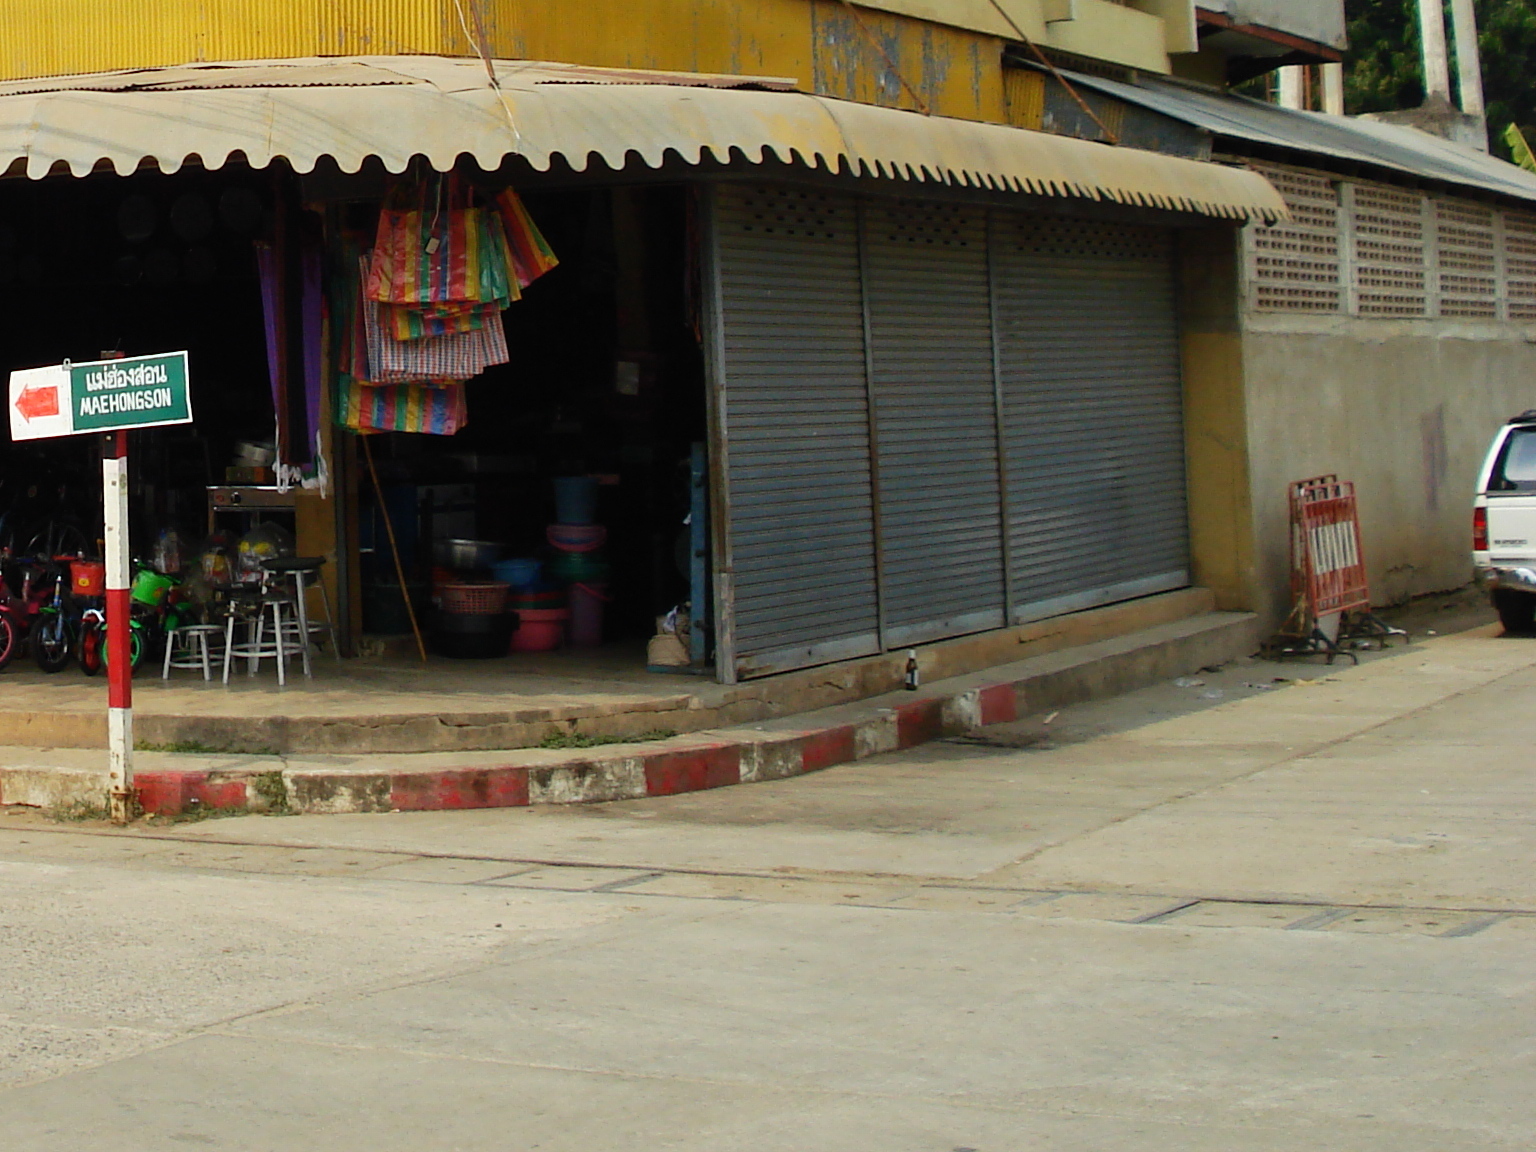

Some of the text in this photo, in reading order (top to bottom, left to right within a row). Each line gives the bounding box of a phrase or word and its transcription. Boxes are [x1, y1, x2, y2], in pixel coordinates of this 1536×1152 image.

[86, 364, 168, 391] แม่ฮ่องสอน
[80, 387, 171, 416] MAEHONGSON
